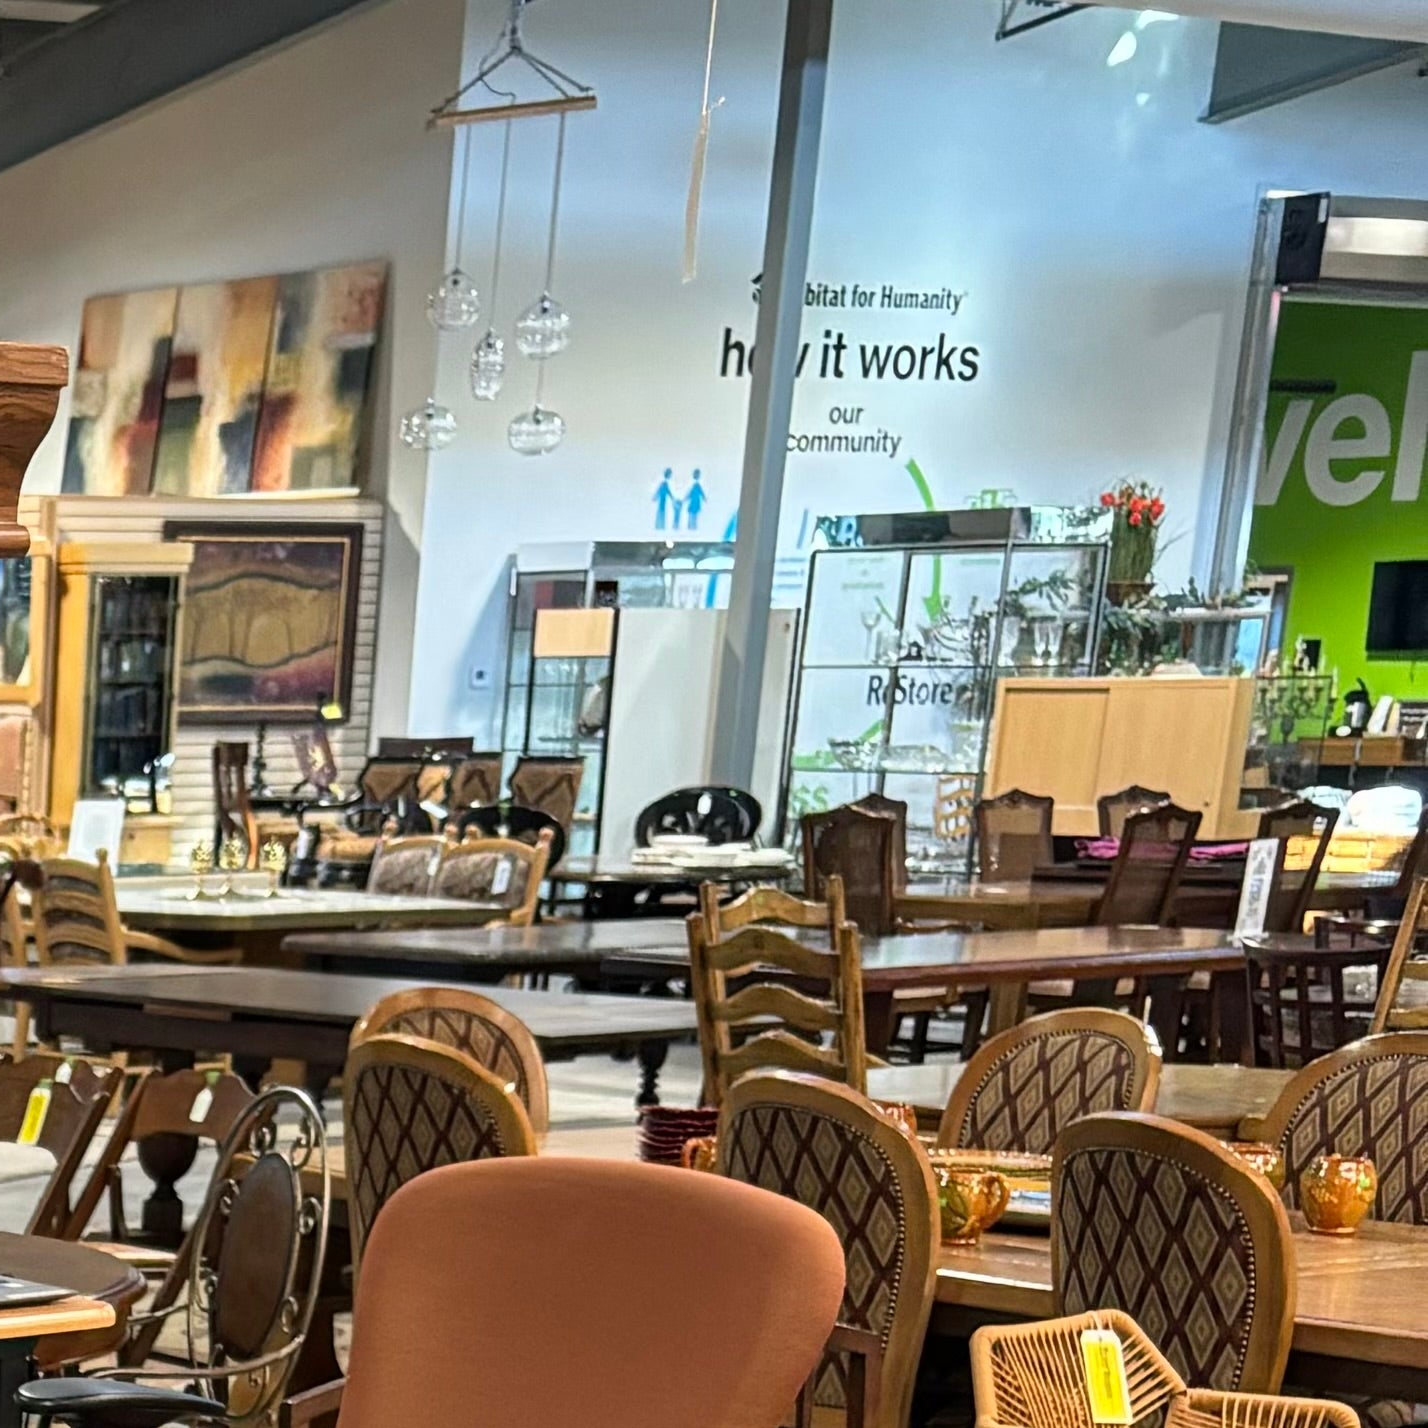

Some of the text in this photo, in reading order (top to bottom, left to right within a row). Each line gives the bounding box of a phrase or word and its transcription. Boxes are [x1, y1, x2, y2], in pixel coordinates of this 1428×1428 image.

[804, 283, 964, 316] bitat for Humanity
[819, 329, 847, 379] it
[859, 332, 981, 382] works
[828, 405, 865, 425] our
[786, 428, 902, 459] community
